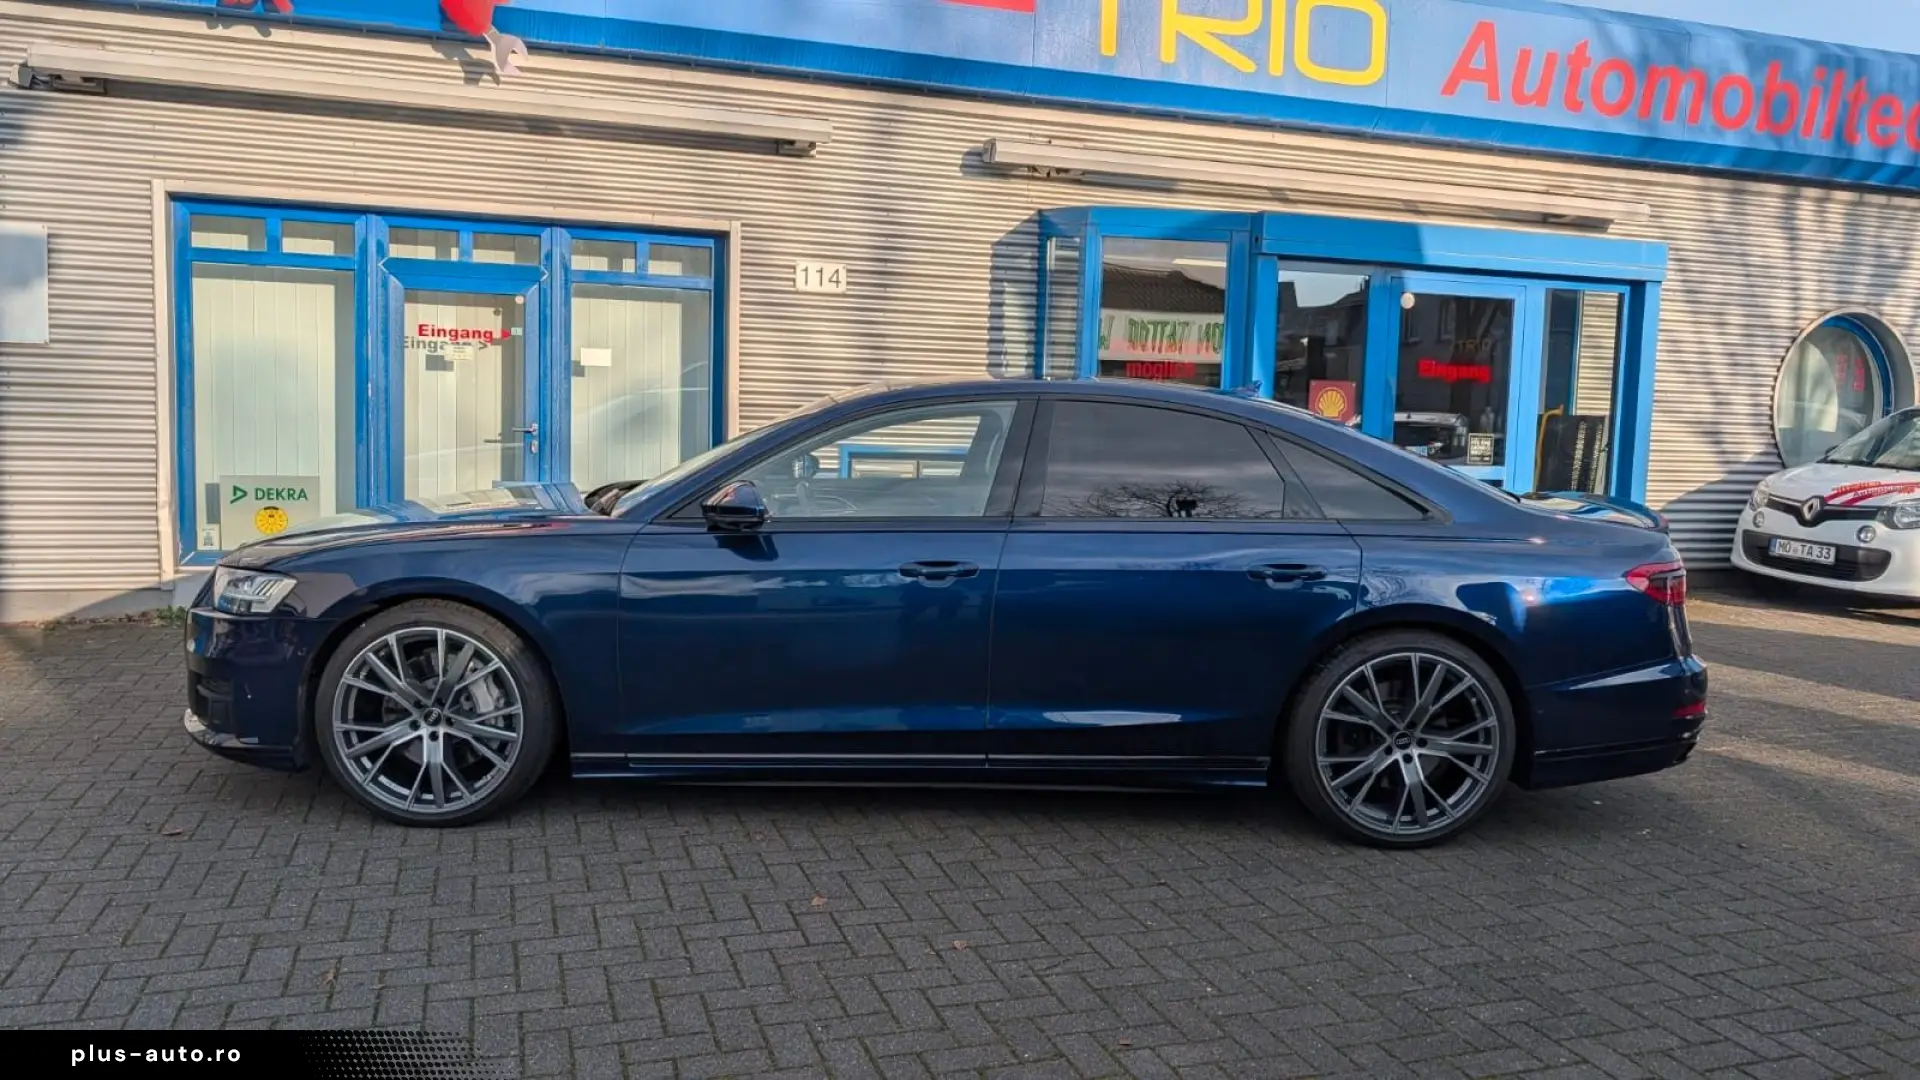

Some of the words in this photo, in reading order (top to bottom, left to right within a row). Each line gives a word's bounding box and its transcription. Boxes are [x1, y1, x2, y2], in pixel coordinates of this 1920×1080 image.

[799, 265, 842, 289] 114
[418, 324, 494, 344] Eingang
[1418, 359, 1491, 384] Eingang
[254, 487, 309, 501] DEKRA
[1816, 546, 1831, 560] 33
